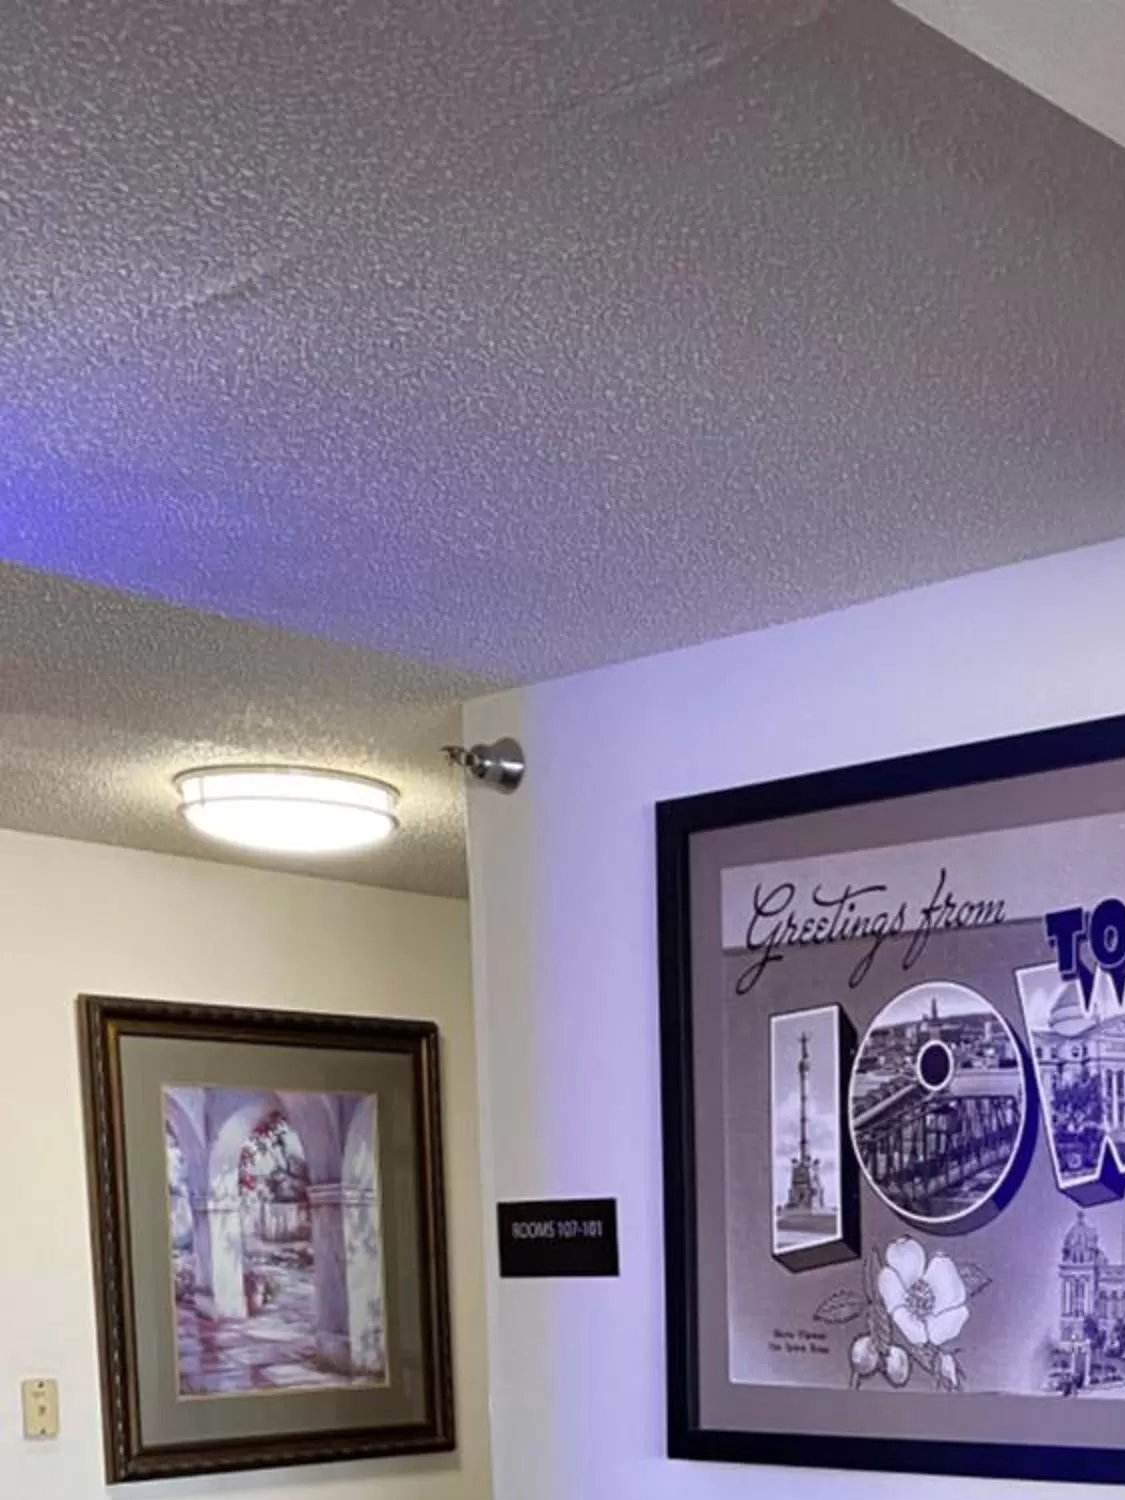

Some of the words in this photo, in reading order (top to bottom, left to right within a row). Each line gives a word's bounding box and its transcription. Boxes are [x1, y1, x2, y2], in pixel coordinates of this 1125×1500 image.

[735, 882, 907, 995] Greetings
[901, 867, 1006, 971] from
[511, 1220, 556, 1239] ROOMS
